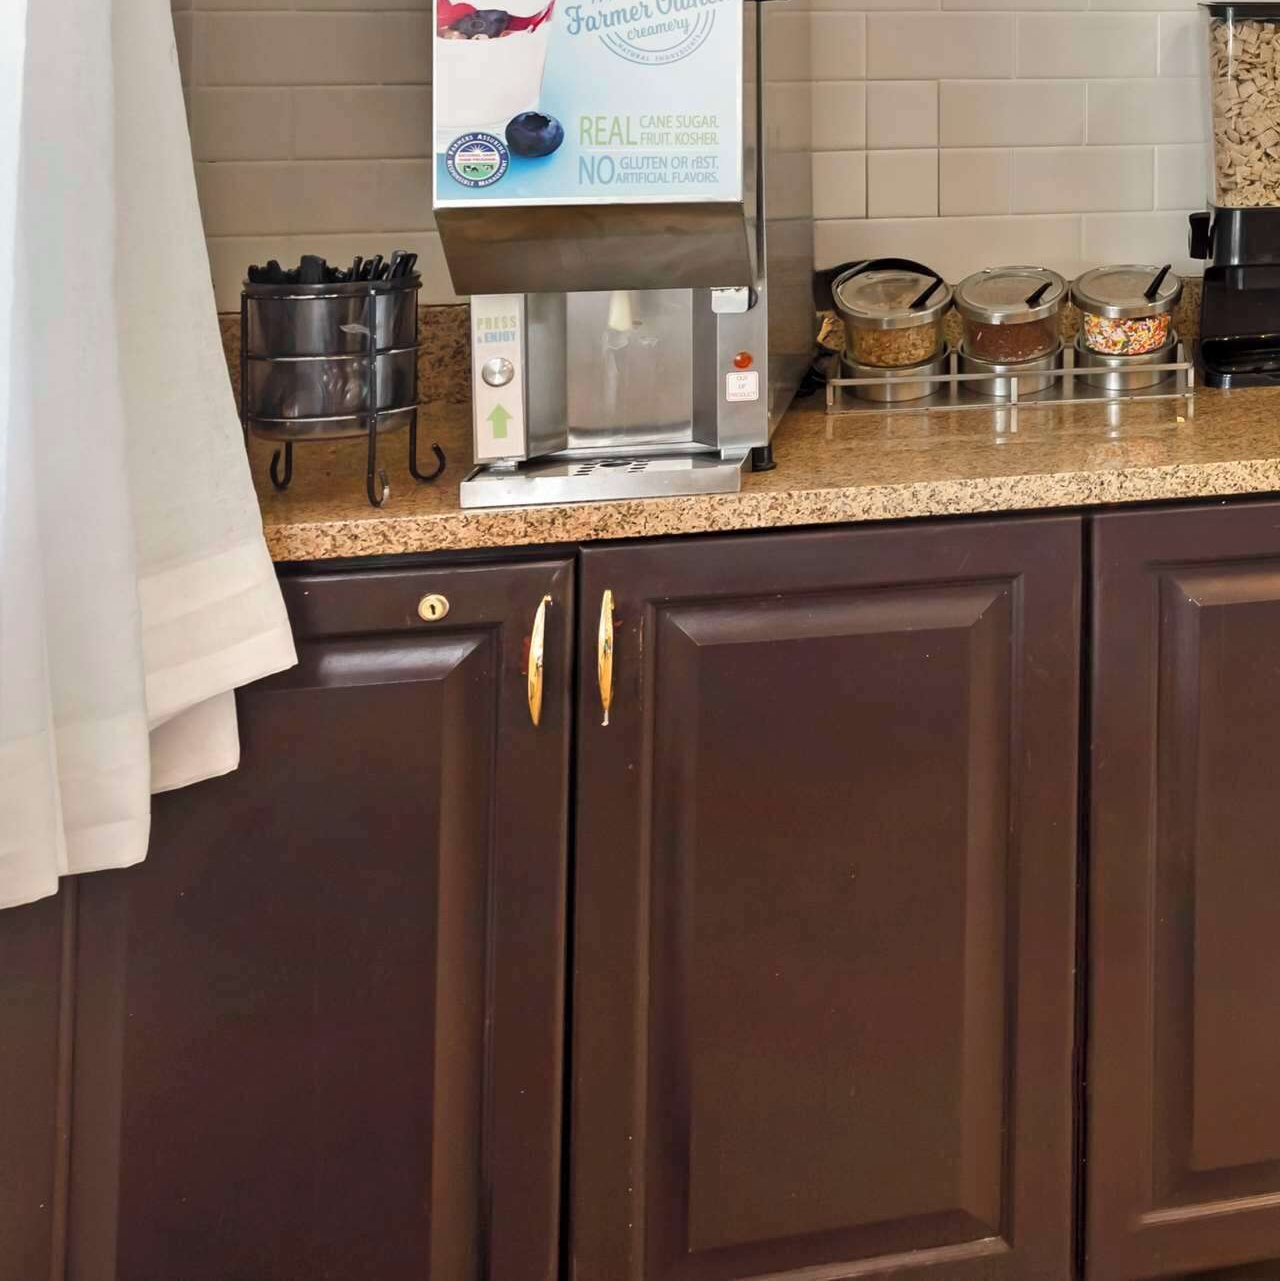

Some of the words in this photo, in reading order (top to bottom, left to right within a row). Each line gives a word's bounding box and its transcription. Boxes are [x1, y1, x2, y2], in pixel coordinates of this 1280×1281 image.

[564, 1, 653, 35] Farmer
[626, 17, 689, 41] creamery
[579, 115, 638, 146] REAL
[639, 115, 673, 129] CANE
[578, 155, 615, 185] NO
[620, 156, 668, 170] GLUTEN
[670, 156, 688, 170] OR
[615, 172, 670, 184] ARTIFICIAL
[476, 317, 517, 329] PRESS
[484, 330, 516, 343] ENJOY
